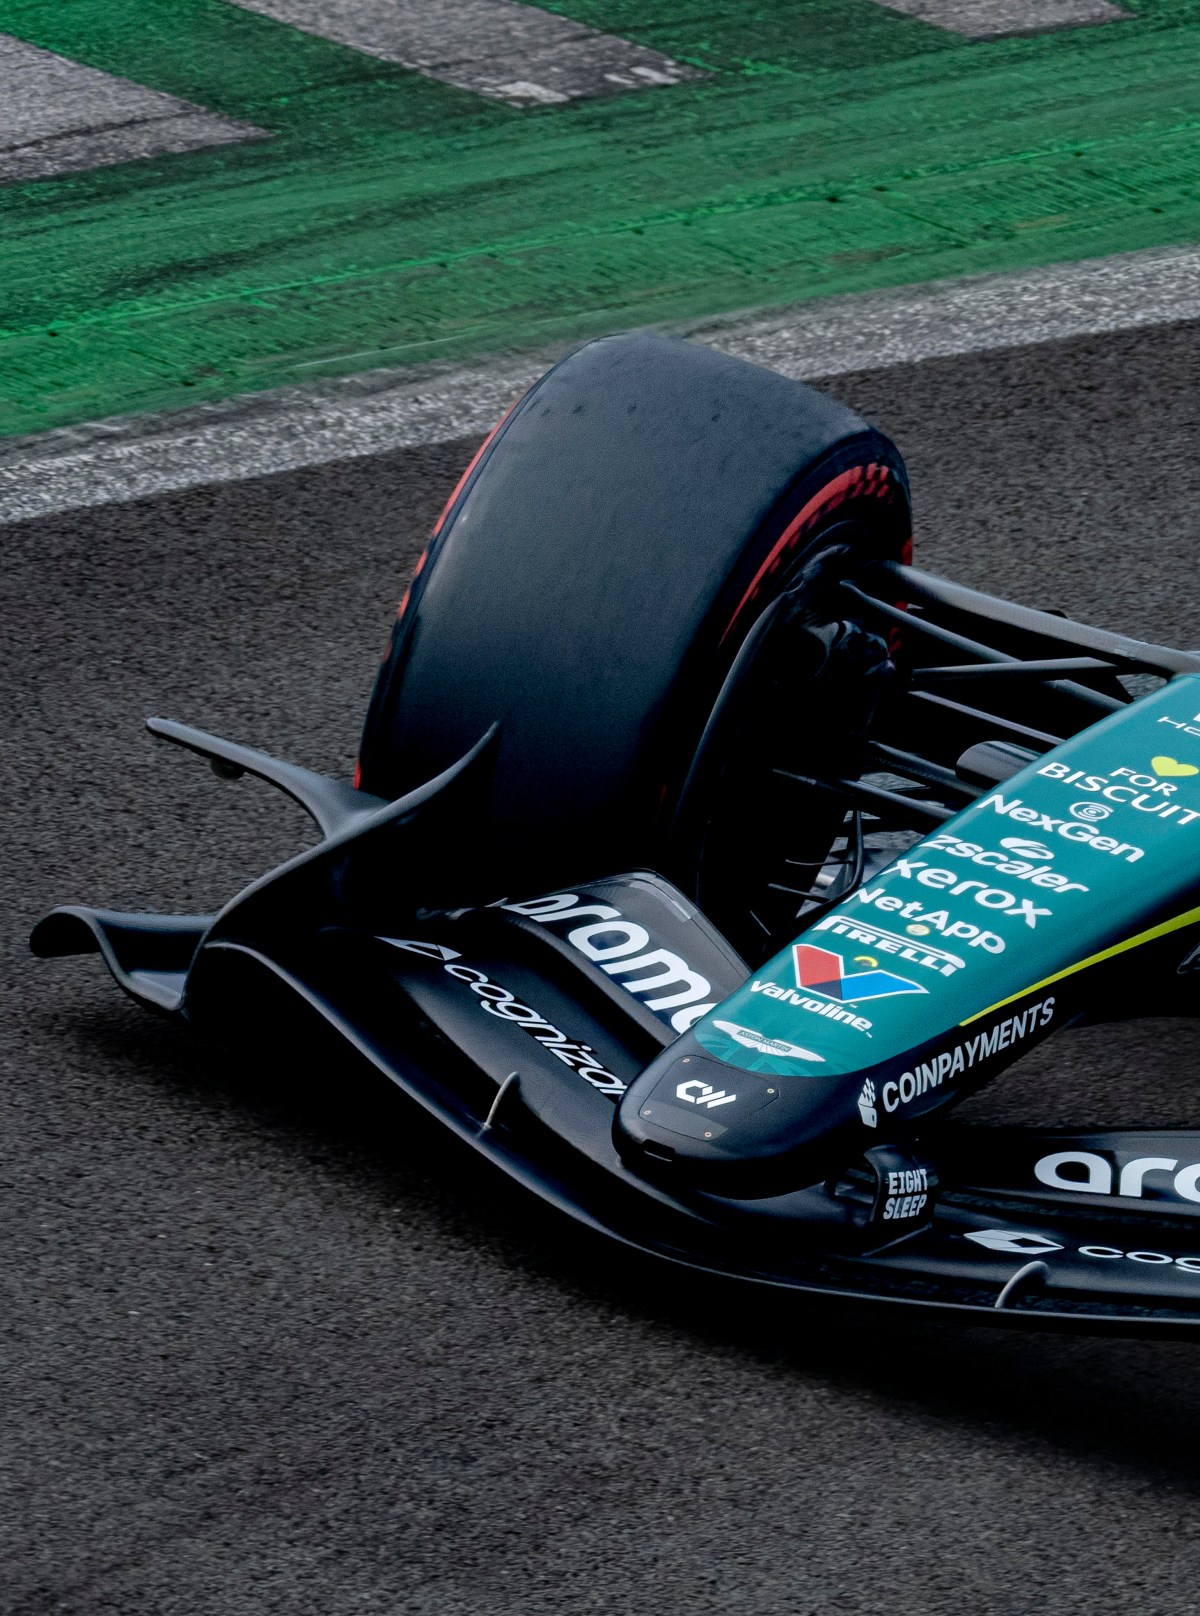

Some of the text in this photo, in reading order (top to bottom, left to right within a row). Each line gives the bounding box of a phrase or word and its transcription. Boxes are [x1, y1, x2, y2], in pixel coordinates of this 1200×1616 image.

[1108, 766, 1179, 797] FOR
[975, 794, 1146, 864] NexGen
[880, 858, 1053, 930] xerox
[917, 834, 1091, 894] zscaler
[811, 914, 967, 978] PIRELLI
[841, 886, 1007, 955] NetApp
[749, 979, 874, 1033] Valvoline
[881, 996, 1057, 1114] COINPAYMENTS
[883, 1193, 928, 1220] SLEEP
[887, 1168, 929, 1196] EIGHT
